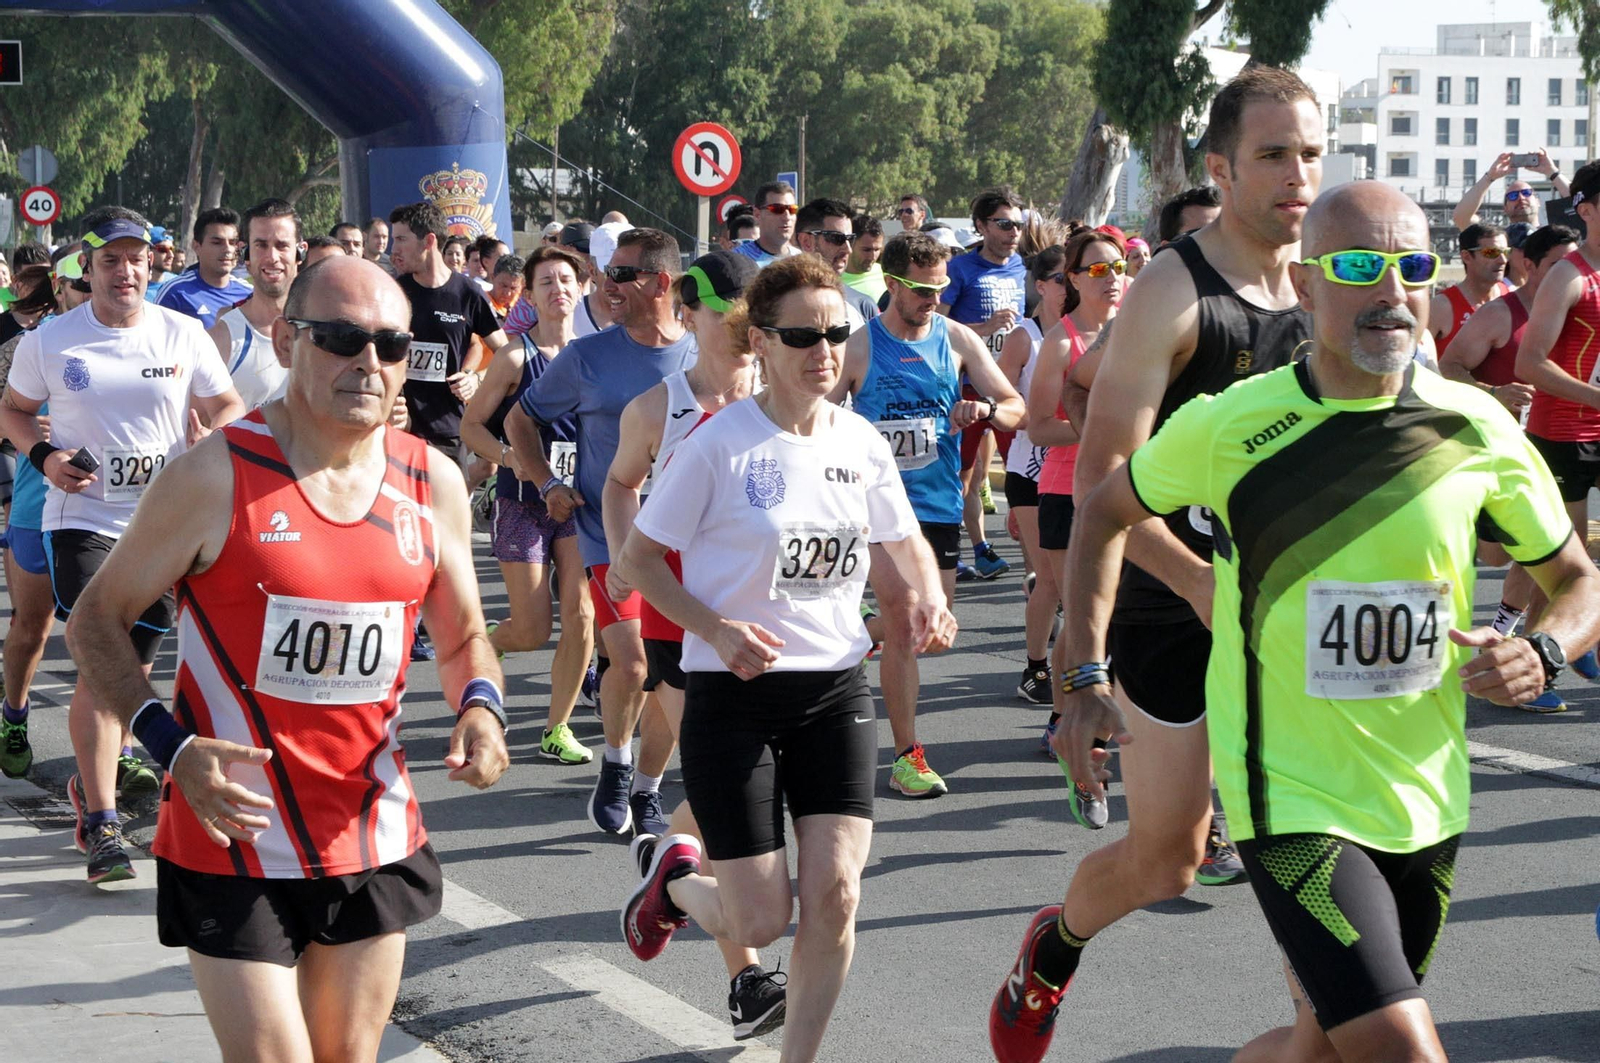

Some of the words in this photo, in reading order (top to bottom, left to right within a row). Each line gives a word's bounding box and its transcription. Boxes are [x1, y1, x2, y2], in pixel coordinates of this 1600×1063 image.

[28, 199, 52, 212] 40
[406, 349, 444, 371] 4278
[141, 367, 175, 378] CNP
[880, 410, 950, 421] NACIONA
[825, 467, 861, 484] CNP
[259, 531, 302, 543] VIATOR
[781, 536, 858, 579] 3296
[1319, 600, 1439, 666] 4004
[273, 618, 383, 677] 4010
[330, 679, 382, 689] DEPORTIVA
[315, 692, 331, 701] 4010
